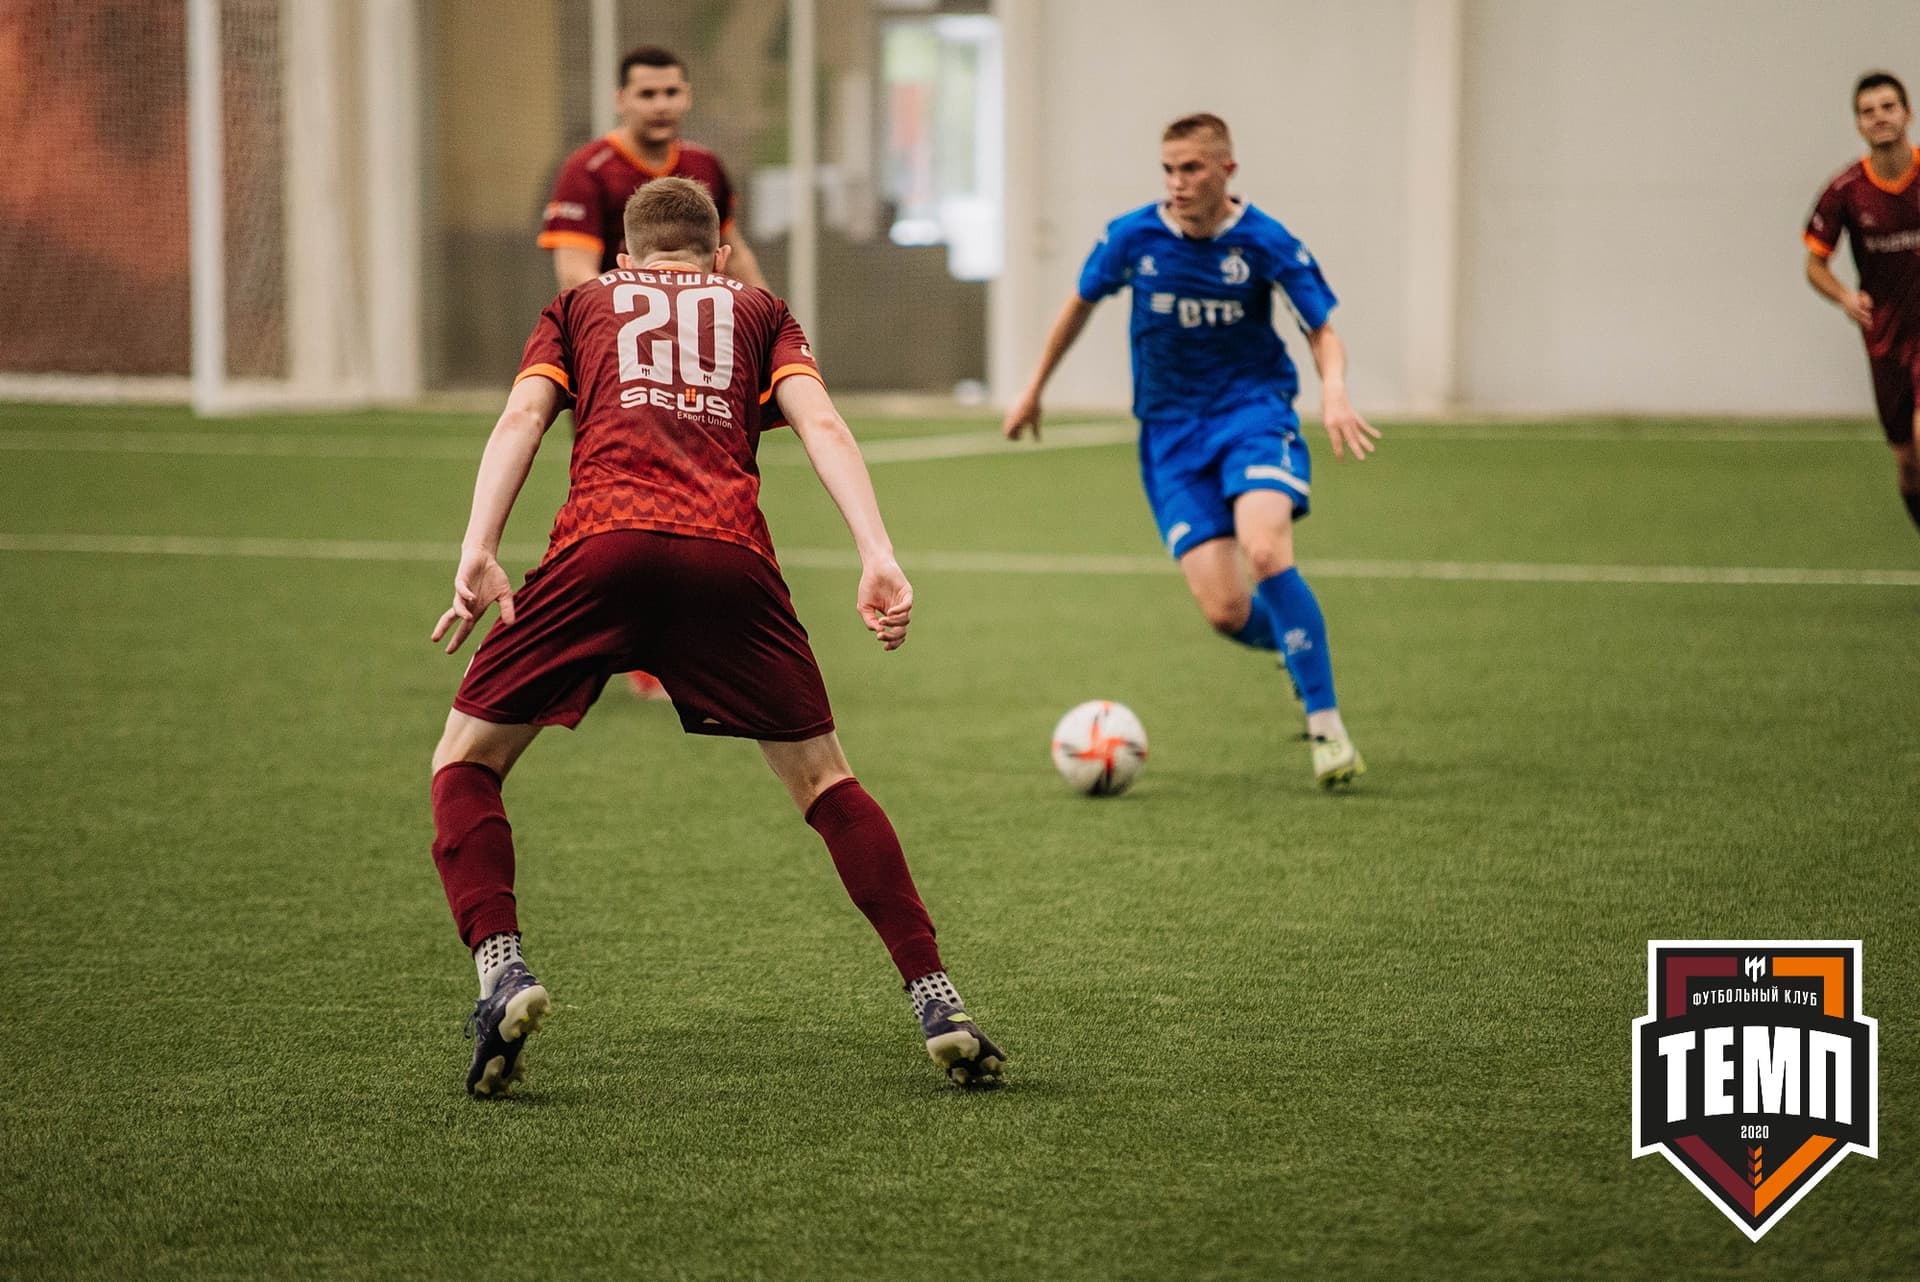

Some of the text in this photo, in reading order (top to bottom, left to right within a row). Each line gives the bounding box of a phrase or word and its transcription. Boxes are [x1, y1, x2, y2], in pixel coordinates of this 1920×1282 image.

[612, 284, 735, 391] 20
[677, 410, 733, 430] Export Union
